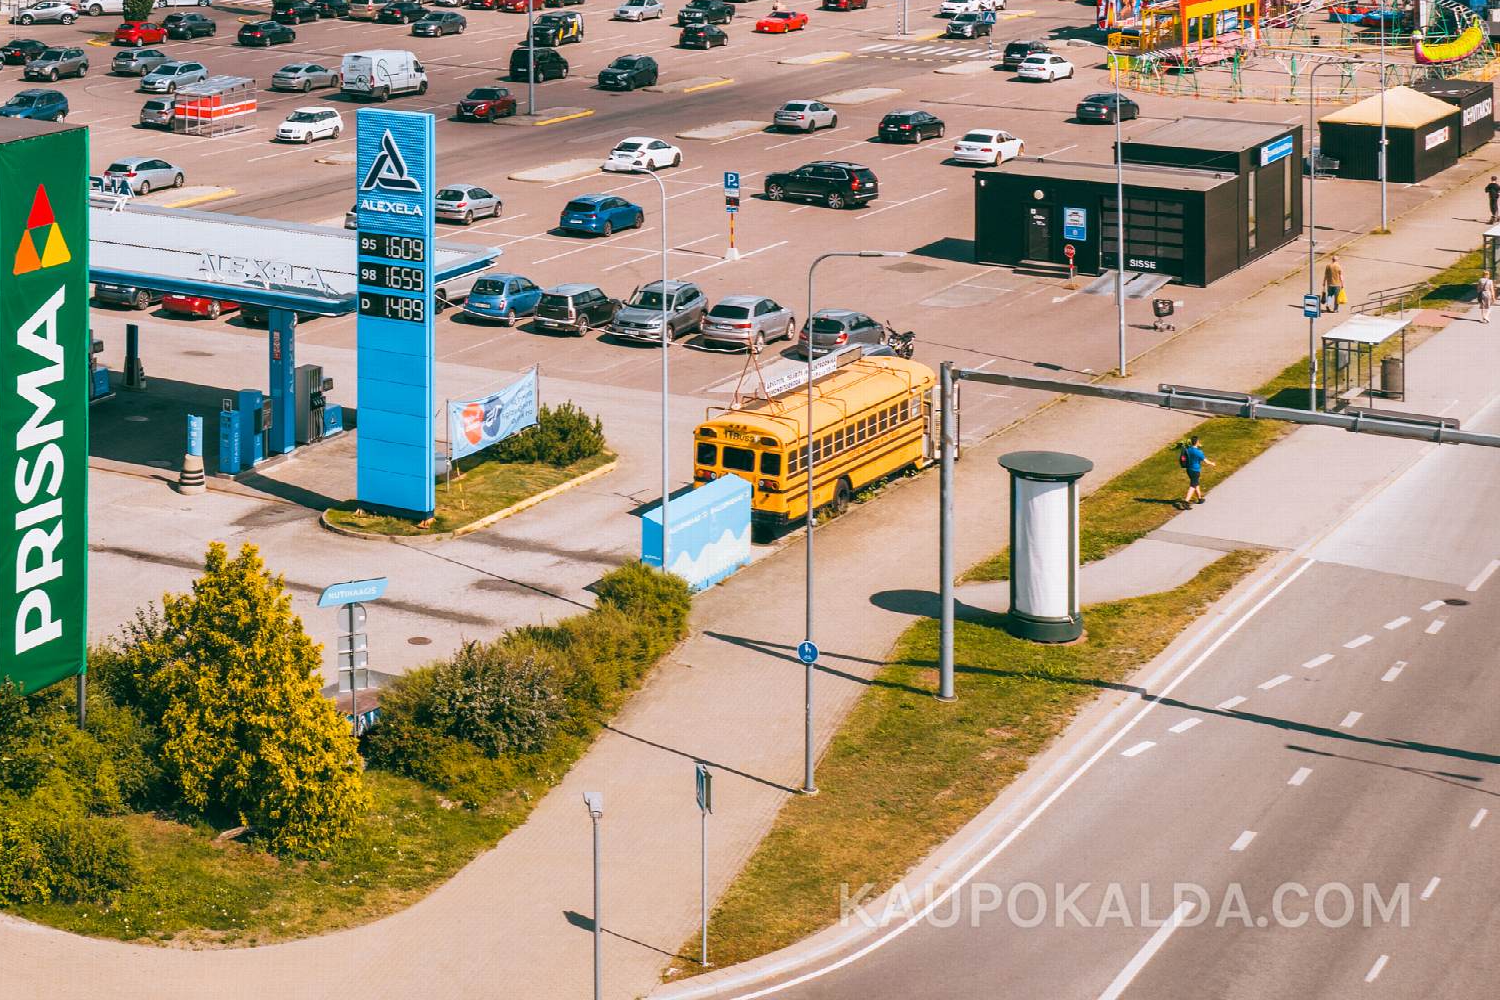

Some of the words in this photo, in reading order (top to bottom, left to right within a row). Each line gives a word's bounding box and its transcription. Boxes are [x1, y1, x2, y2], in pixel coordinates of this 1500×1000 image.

[361, 199, 424, 217] ALEXELA
[361, 238, 377, 250] 95
[385, 236, 424, 261] 1.609
[1129, 259, 1157, 269] SISSE
[361, 268, 377, 281] 98
[385, 266, 424, 291] 1.659
[361, 298, 371, 309] D
[385, 297, 424, 321] 1.489
[15, 285, 66, 656] PRISMA
